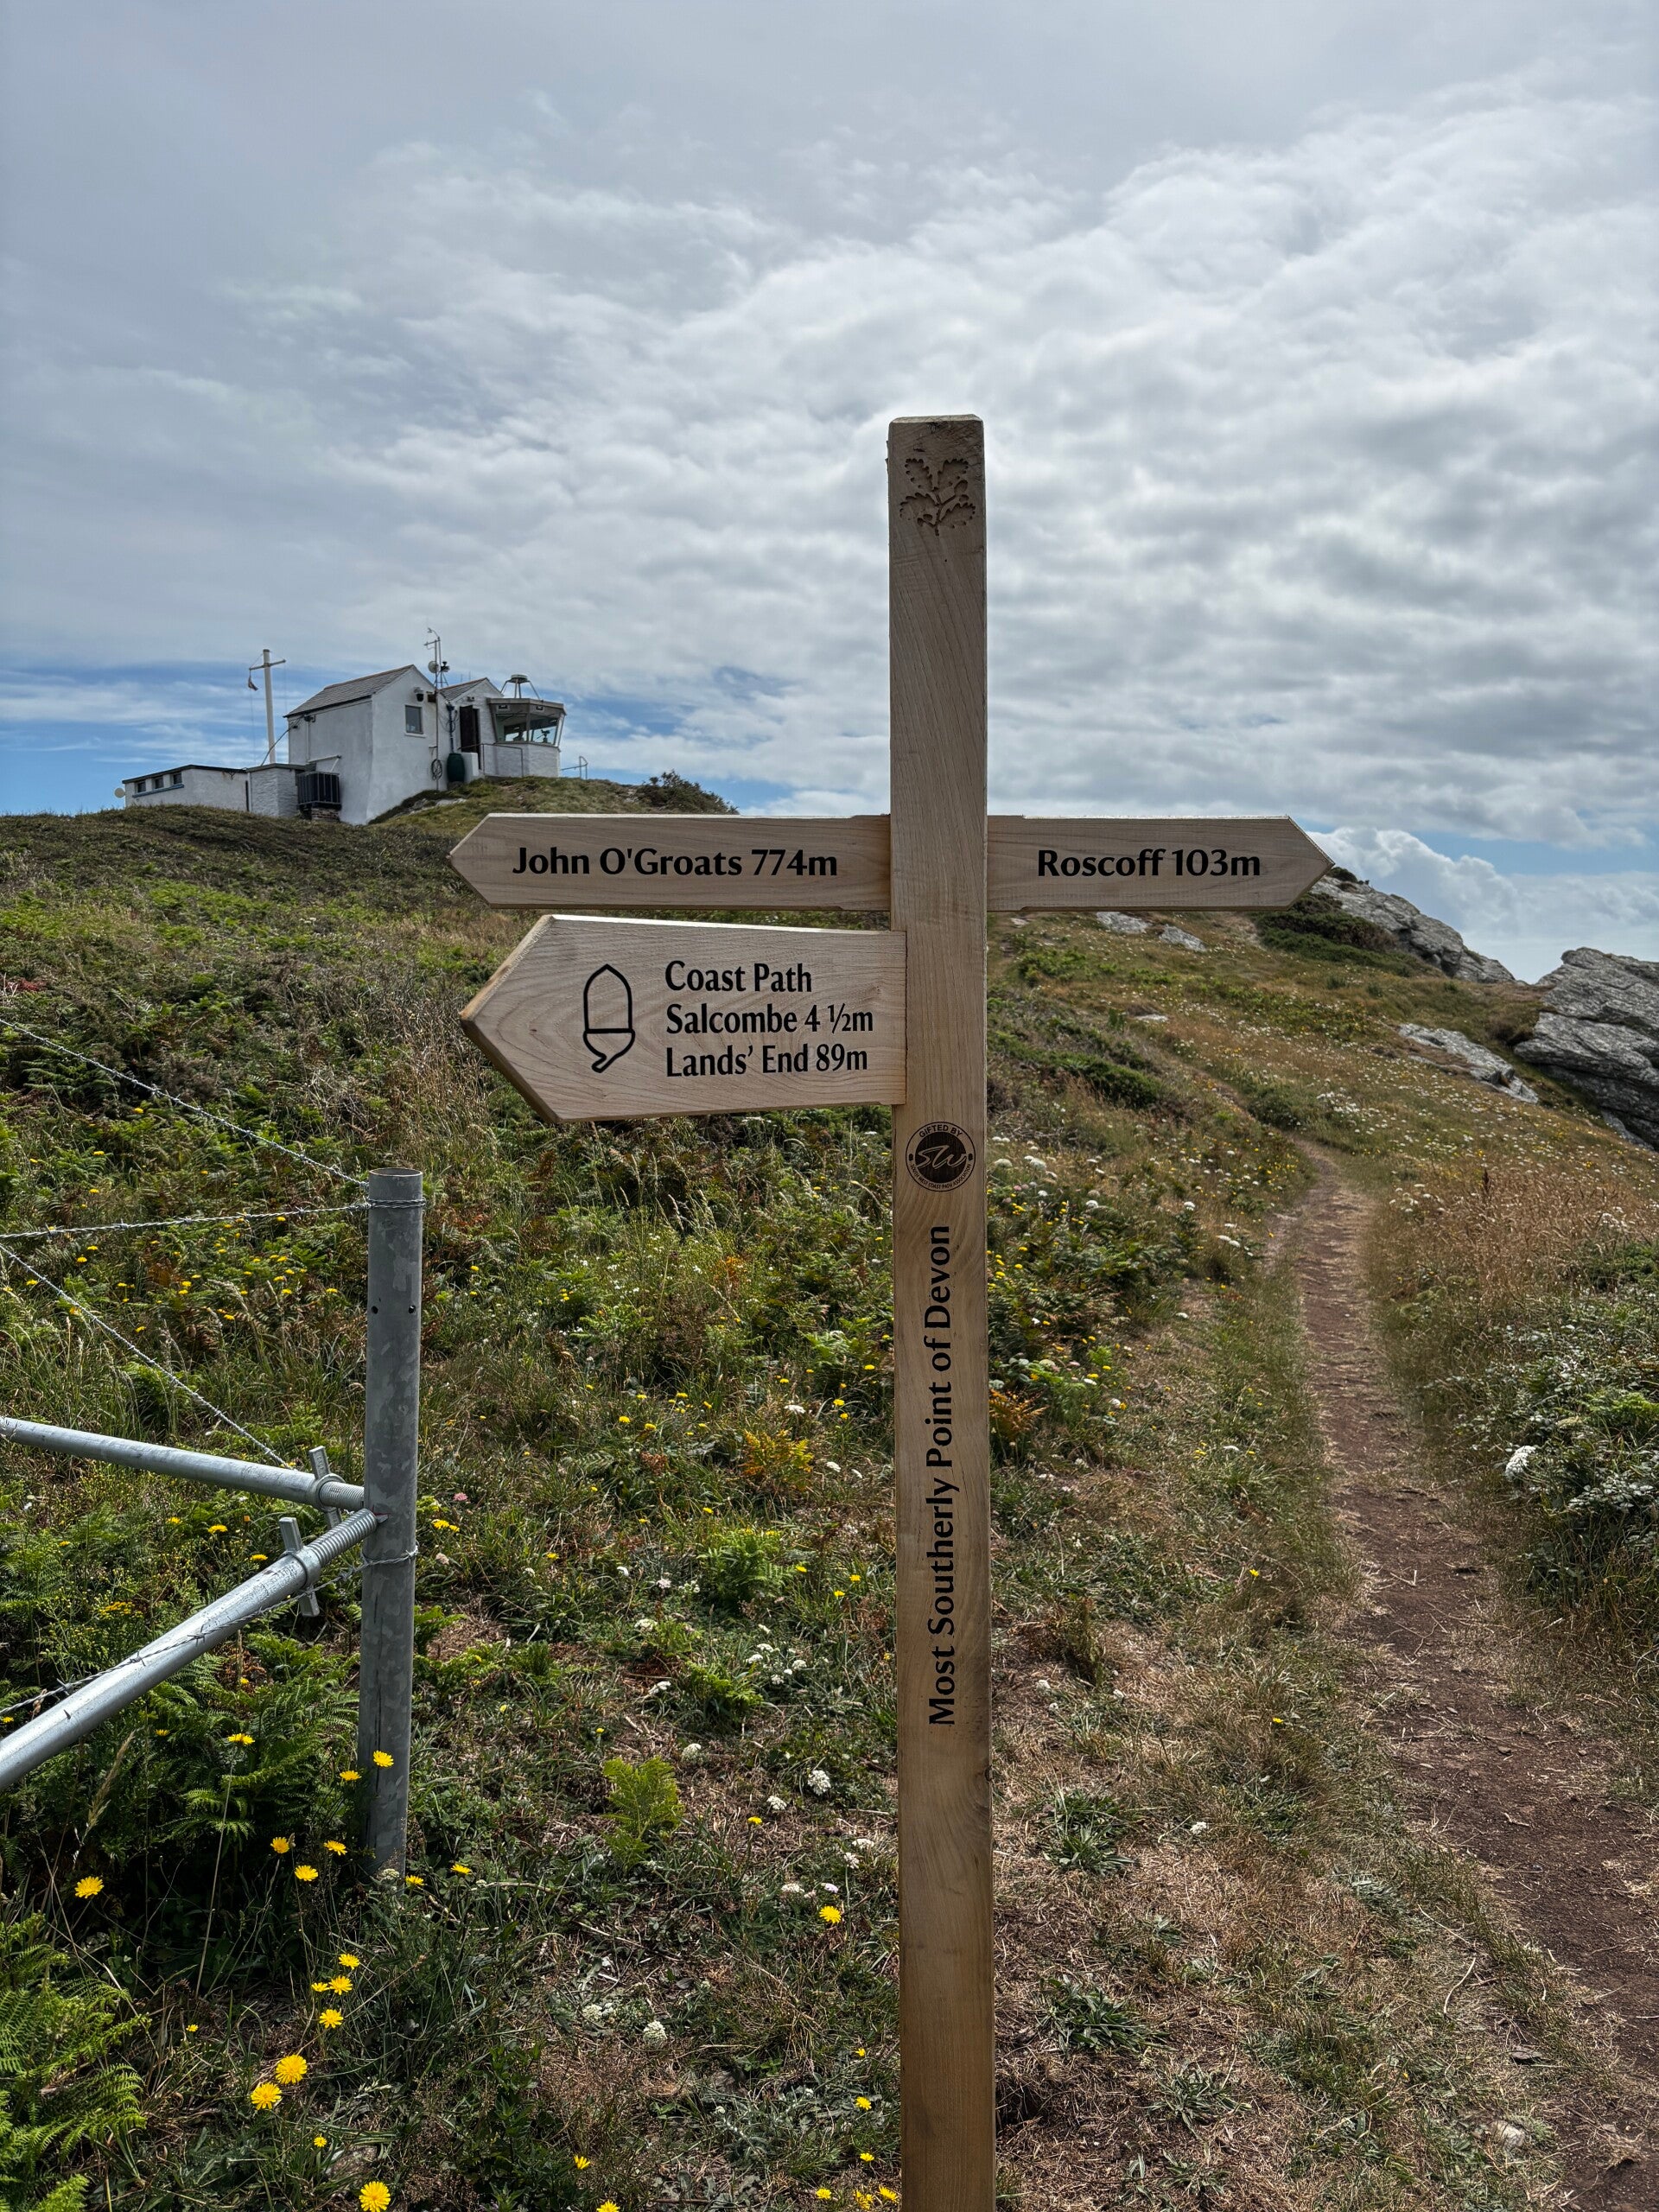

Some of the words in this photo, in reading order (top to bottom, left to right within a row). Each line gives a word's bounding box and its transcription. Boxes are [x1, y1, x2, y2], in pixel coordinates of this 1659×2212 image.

[512, 846, 590, 875] John
[599, 847, 742, 877] O'Groats
[751, 848, 838, 877] 774m
[1038, 847, 1166, 877] Roscoff
[1171, 848, 1261, 877] 103m
[664, 959, 747, 993] Coast
[753, 962, 812, 994] Path
[665, 1002, 798, 1035] Salcombe
[804, 1003, 821, 1033] 4
[762, 1044, 809, 1074] End
[816, 1042, 868, 1073] 89m
[918, 1124, 949, 1137] GIFTED
[950, 1127, 963, 1136] BY
[924, 1225, 951, 1329] Devon
[923, 1335, 952, 1372] of
[924, 1381, 954, 1468] Point
[925, 1477, 960, 1636] Southerly
[927, 1645, 957, 1726] Most
